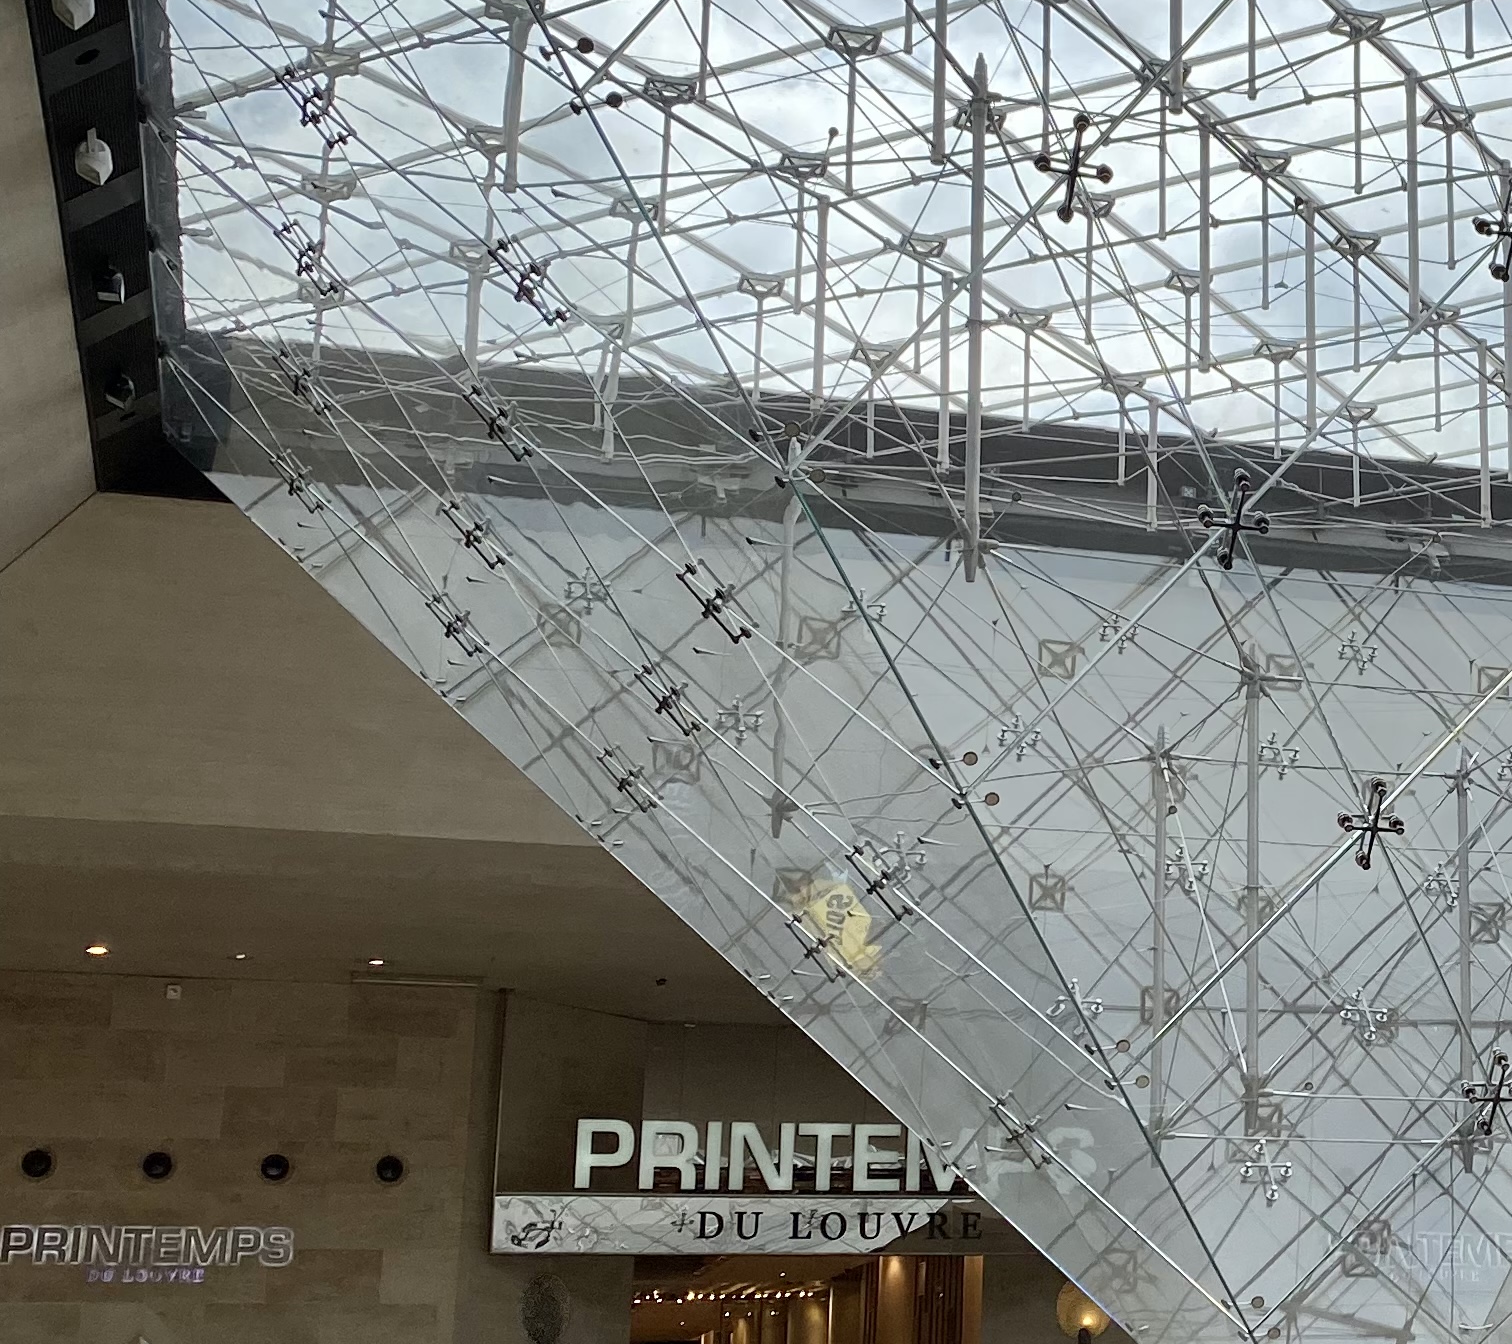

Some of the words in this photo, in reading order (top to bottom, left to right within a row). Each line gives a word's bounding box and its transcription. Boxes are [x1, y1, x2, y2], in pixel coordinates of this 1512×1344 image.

[697, 1211, 762, 1240] DU
[789, 1211, 983, 1240] LOUVRE
[1, 1225, 295, 1267] PRINTEMPS
